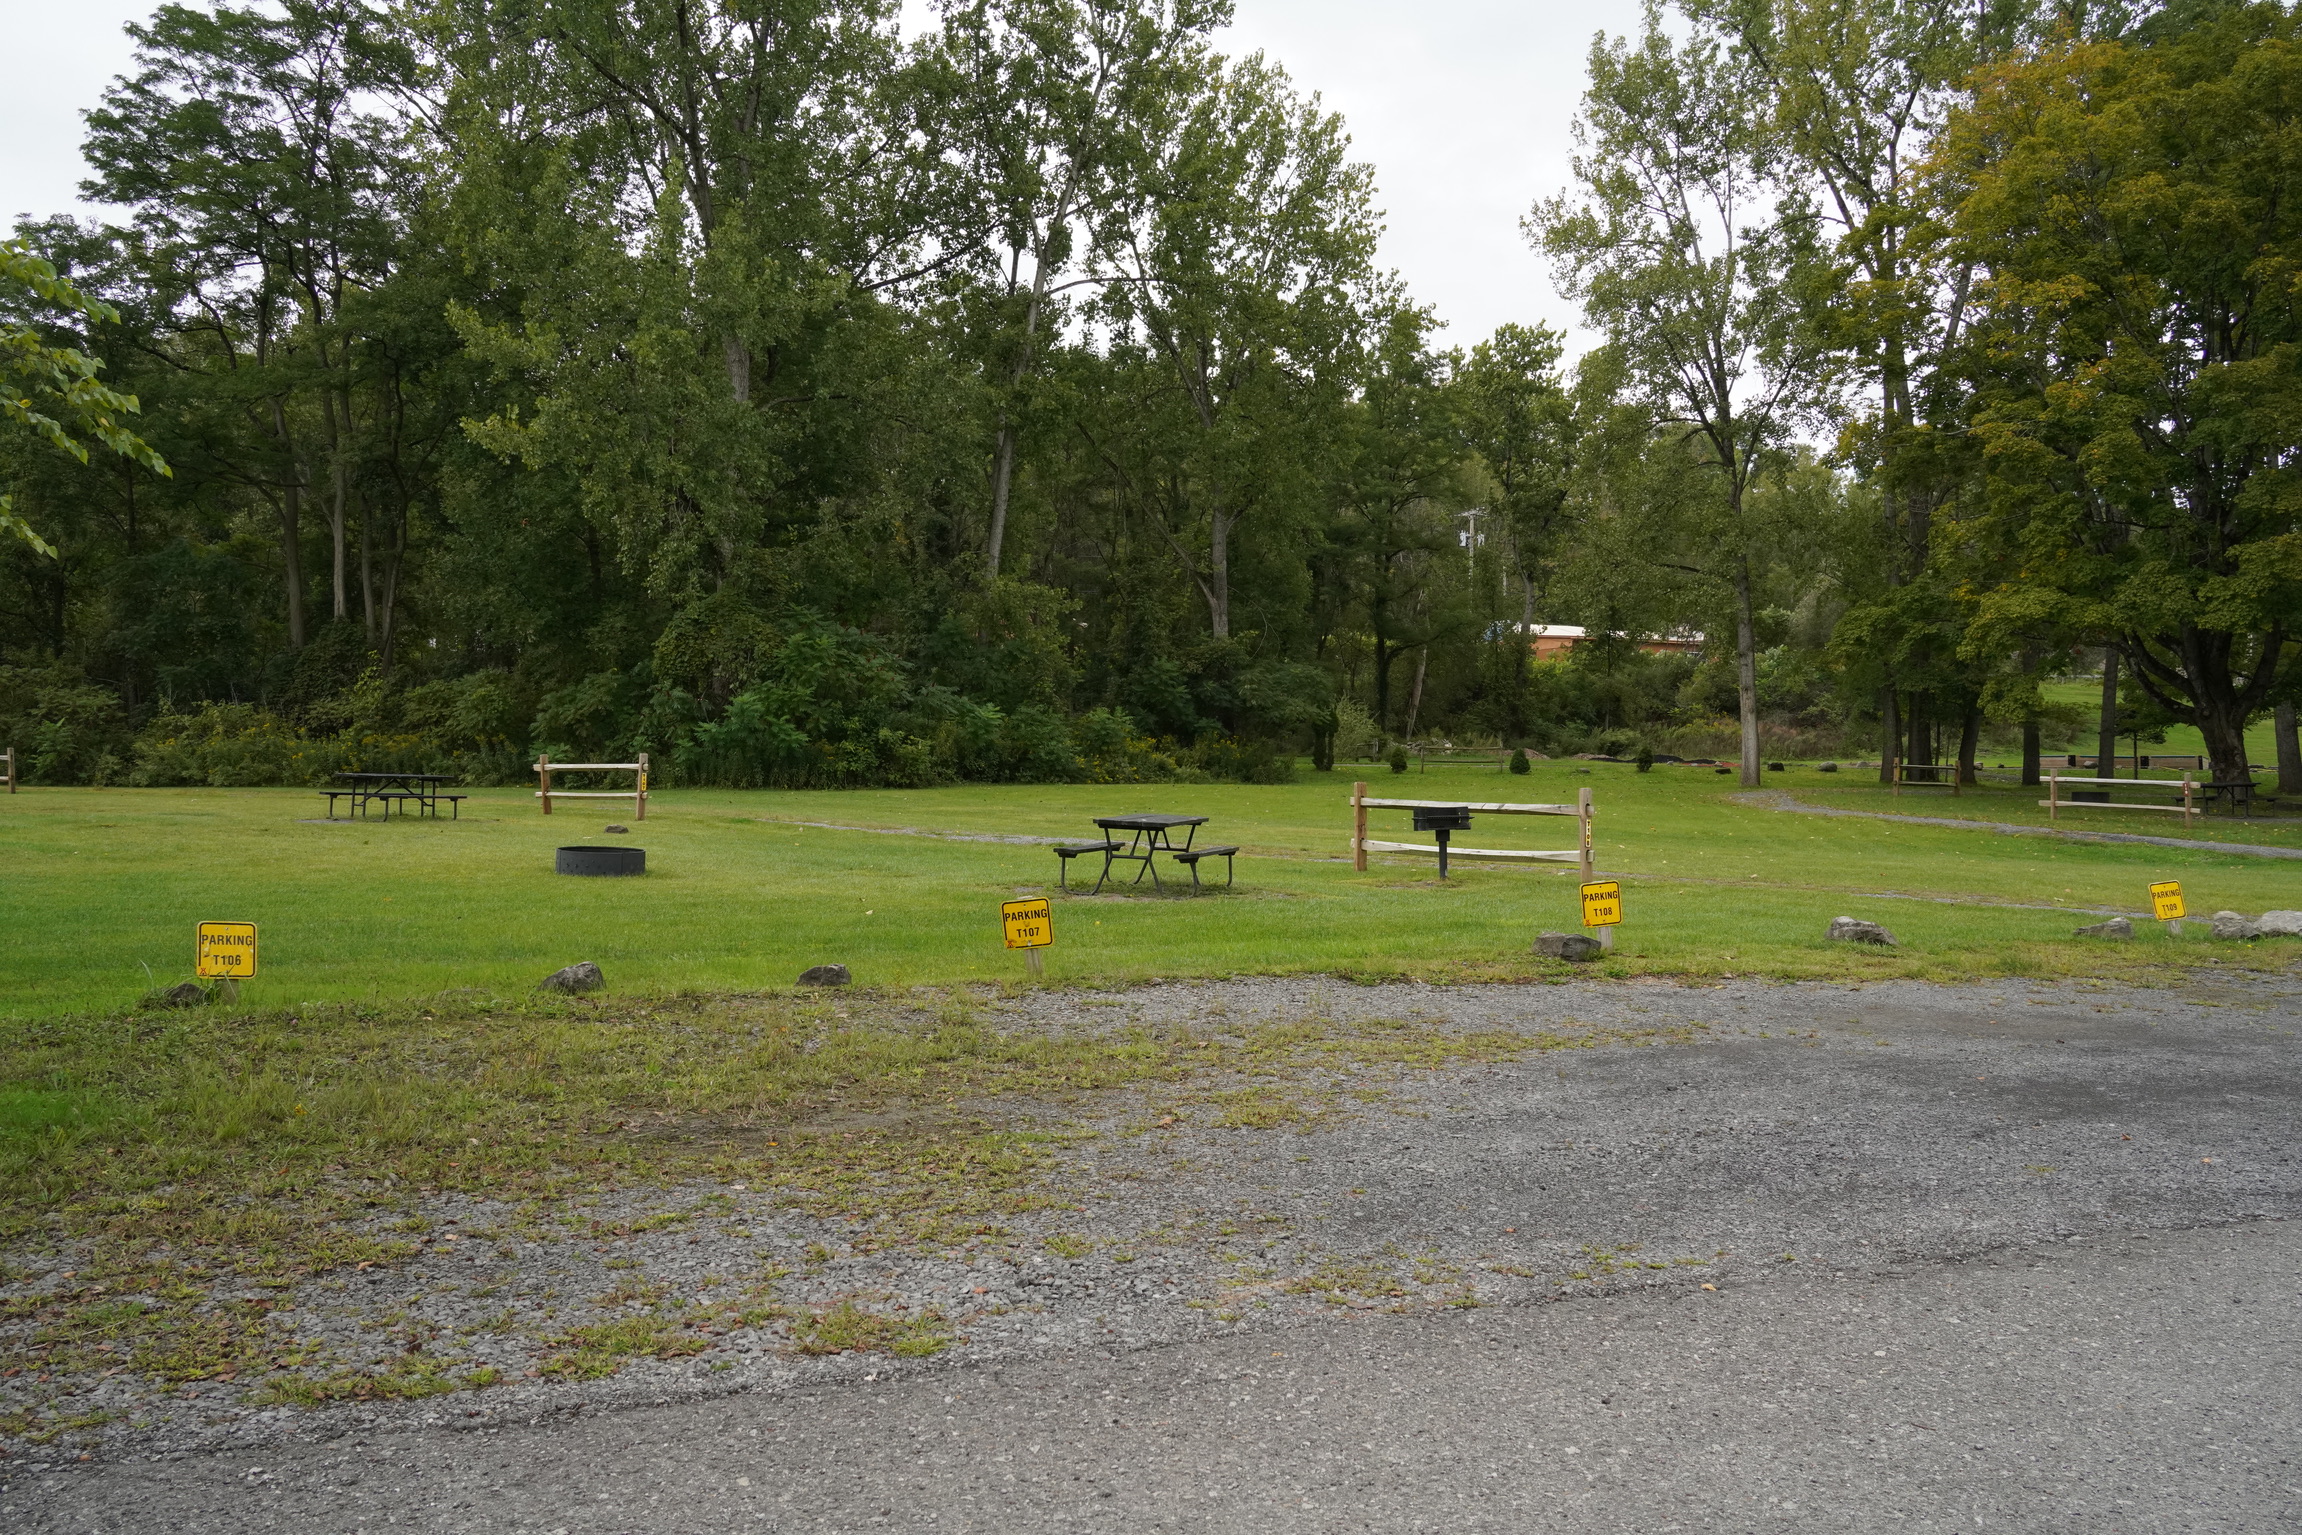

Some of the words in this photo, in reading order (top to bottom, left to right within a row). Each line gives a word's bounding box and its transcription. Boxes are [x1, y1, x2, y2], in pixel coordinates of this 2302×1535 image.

[1583, 890, 1618, 902] PARKING
[2152, 889, 2180, 899] PARKING
[1004, 908, 1047, 922] PARKING
[1593, 907, 1613, 917] T108
[1016, 927, 1040, 938] T107
[201, 934, 253, 947] PARKING
[213, 954, 241, 966] T106
